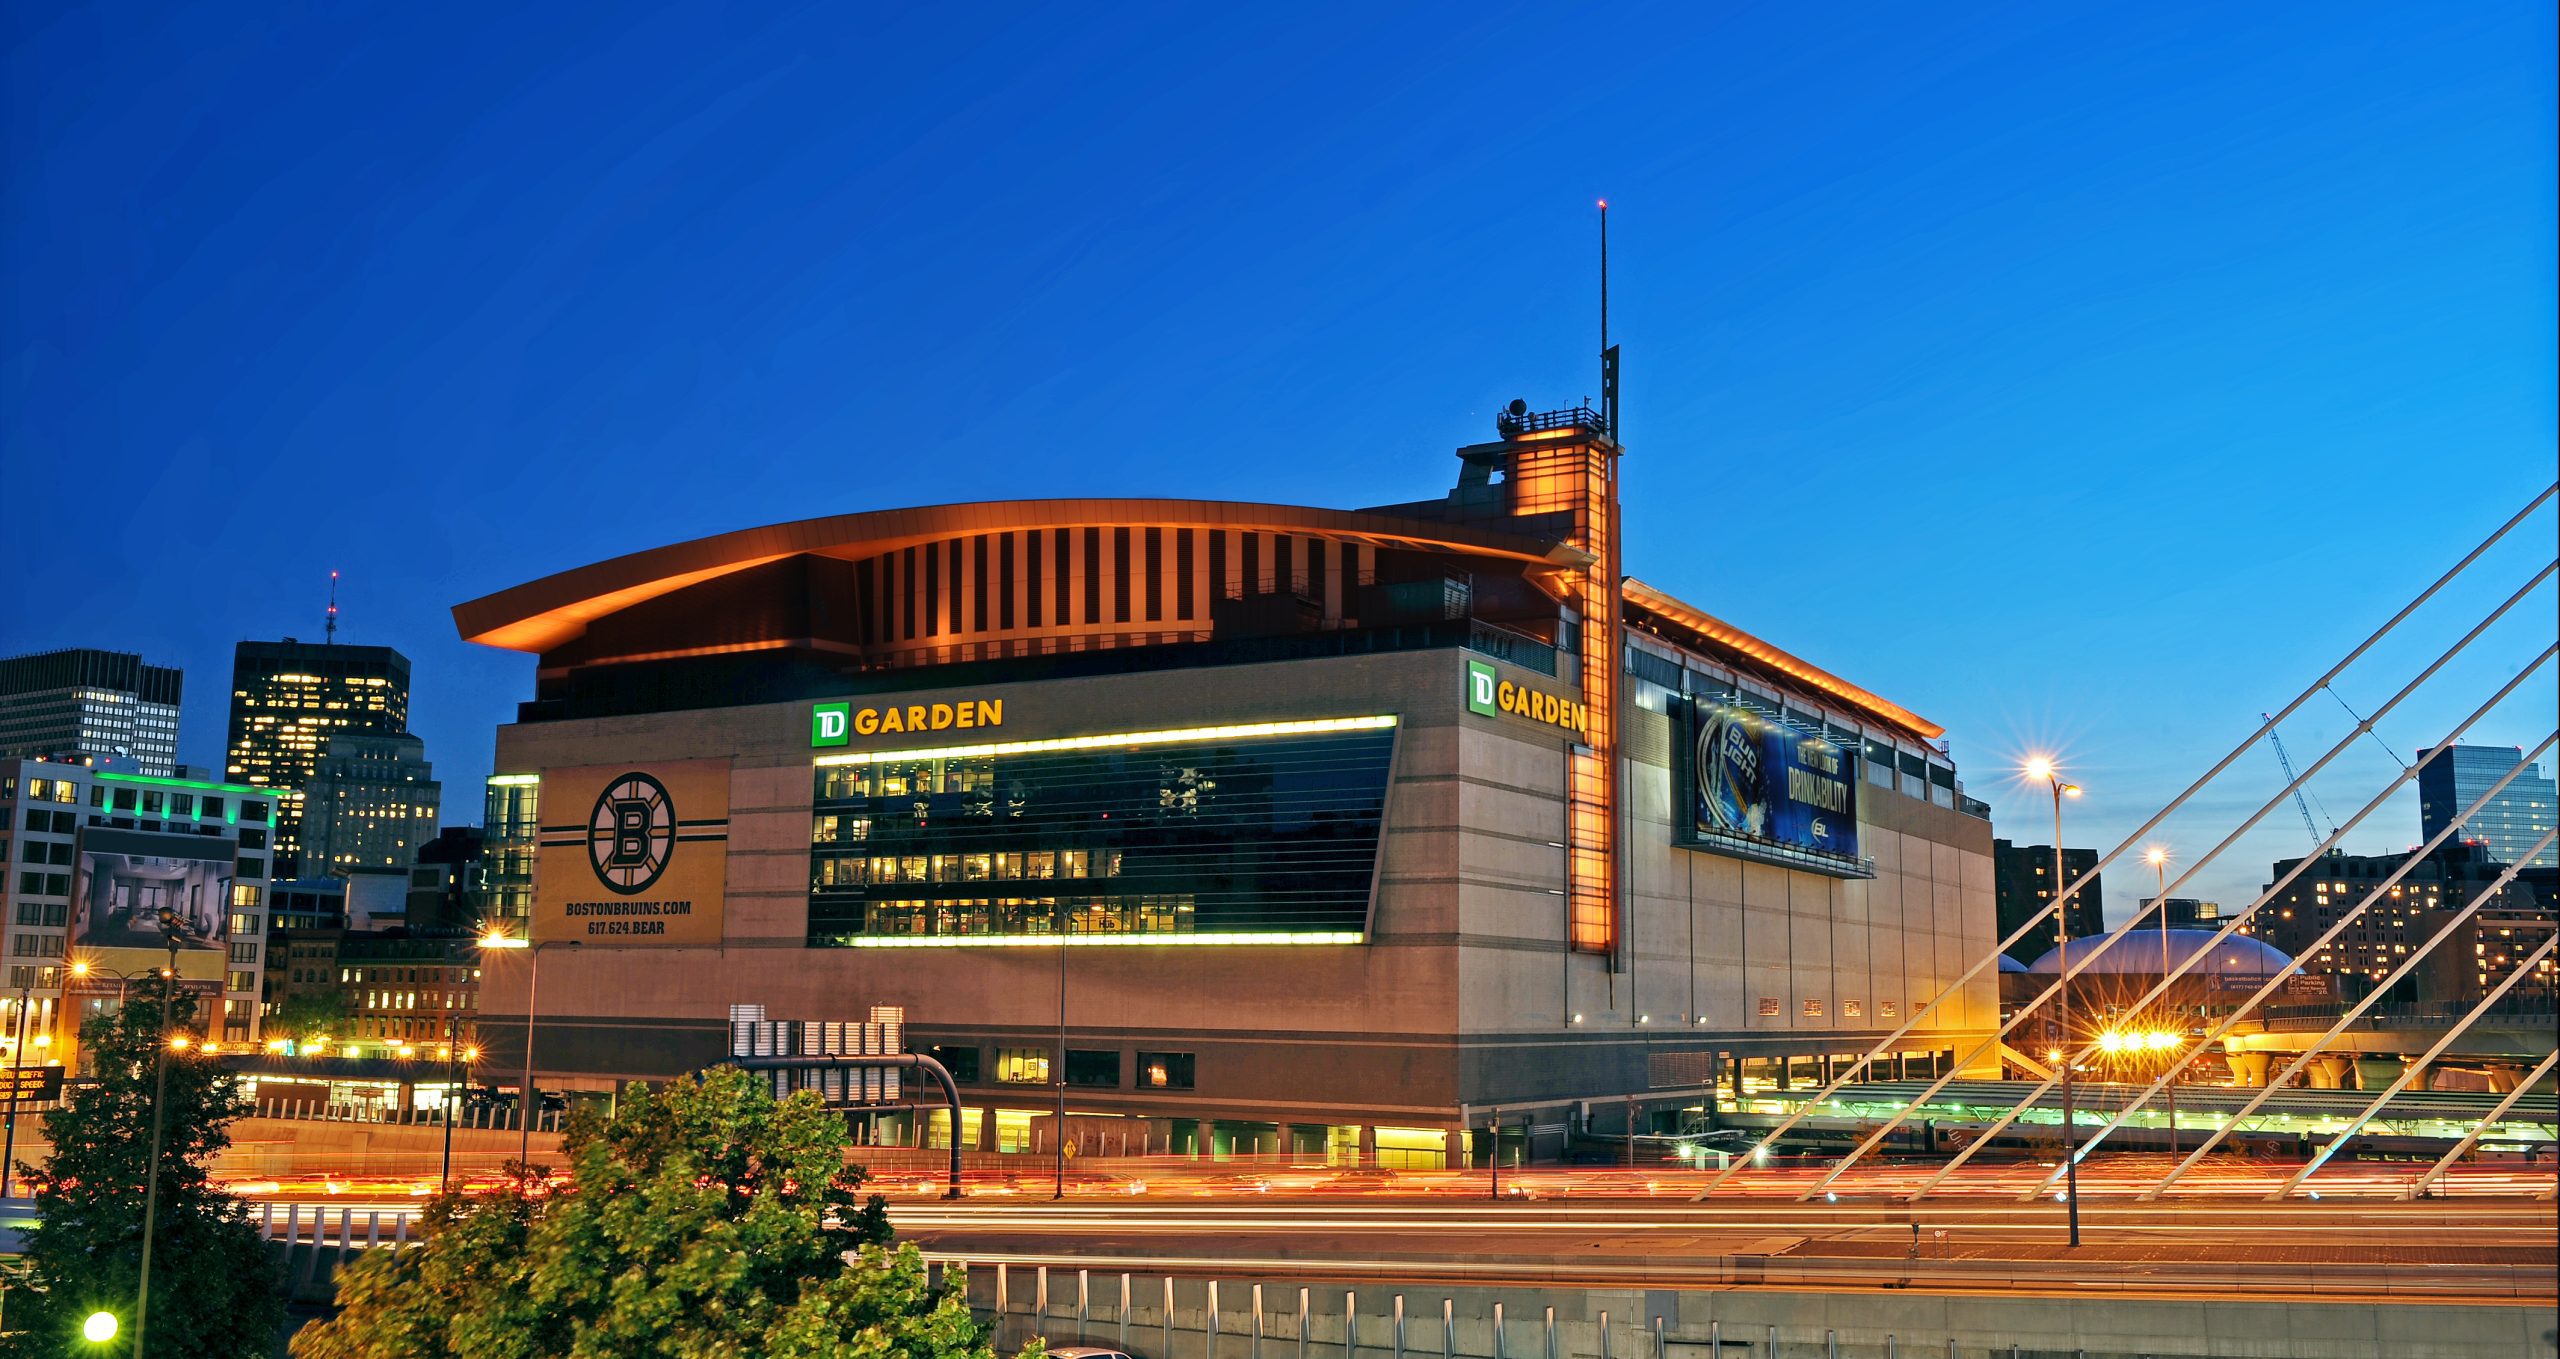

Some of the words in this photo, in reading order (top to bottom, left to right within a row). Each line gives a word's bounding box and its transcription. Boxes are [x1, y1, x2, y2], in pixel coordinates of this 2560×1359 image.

[816, 710, 846, 738] TD
[854, 699, 1002, 735] GARDEN
[1472, 670, 1493, 705] TD
[1498, 680, 1586, 733] GARDEN
[1723, 739, 1757, 784] LIGHT
[1729, 726, 1757, 768] BUD
[1797, 745, 1808, 765] THE
[1788, 766, 1848, 814] DRINKABILITY
[566, 901, 692, 916] BOSTONBRUINS.COM
[588, 921, 665, 935] 617.624.BEAR
